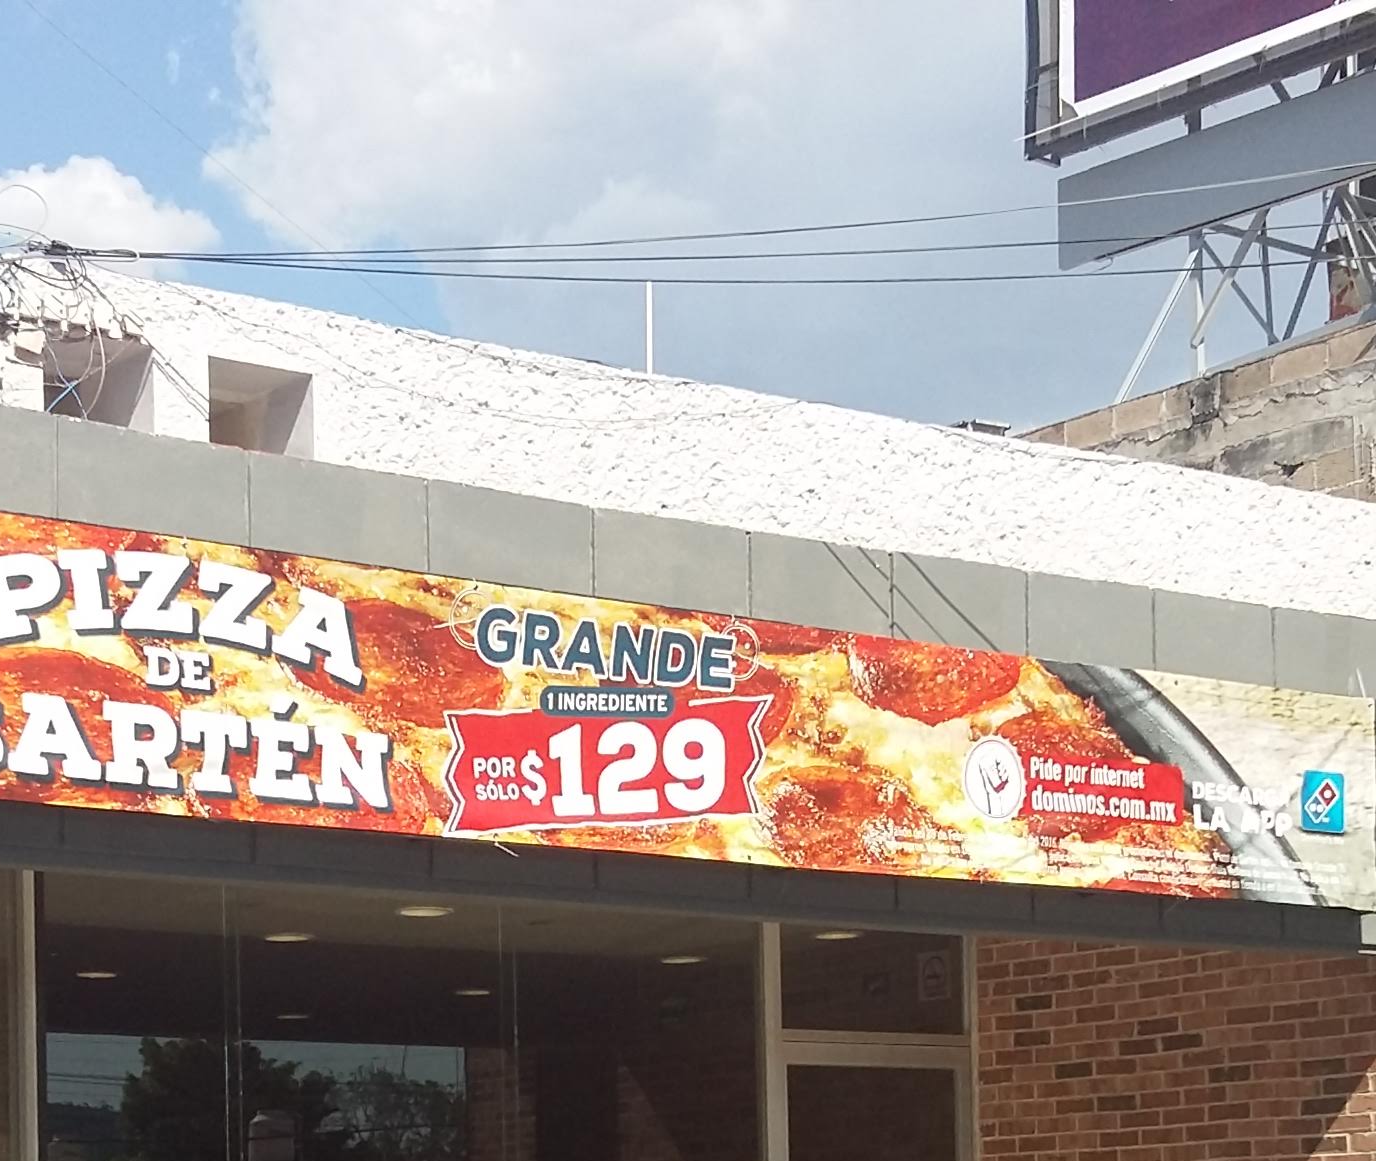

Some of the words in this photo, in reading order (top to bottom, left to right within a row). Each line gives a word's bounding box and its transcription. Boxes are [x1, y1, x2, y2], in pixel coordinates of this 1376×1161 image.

[475, 605, 736, 692] GRANDE
[144, 646, 213, 693] DE
[546, 692, 554, 710] 1
[557, 693, 667, 712] INGREDIENTE
[473, 756, 516, 778] POR
[520, 717, 726, 818] $129
[1029, 756, 1062, 782] Pide
[1064, 763, 1088, 787] por
[1089, 762, 1145, 789] internet
[476, 780, 520, 801] SÓLO
[1031, 784, 1177, 823] dominos.com.mx
[1193, 804, 1231, 832] LA
[1241, 807, 1293, 837] APP
